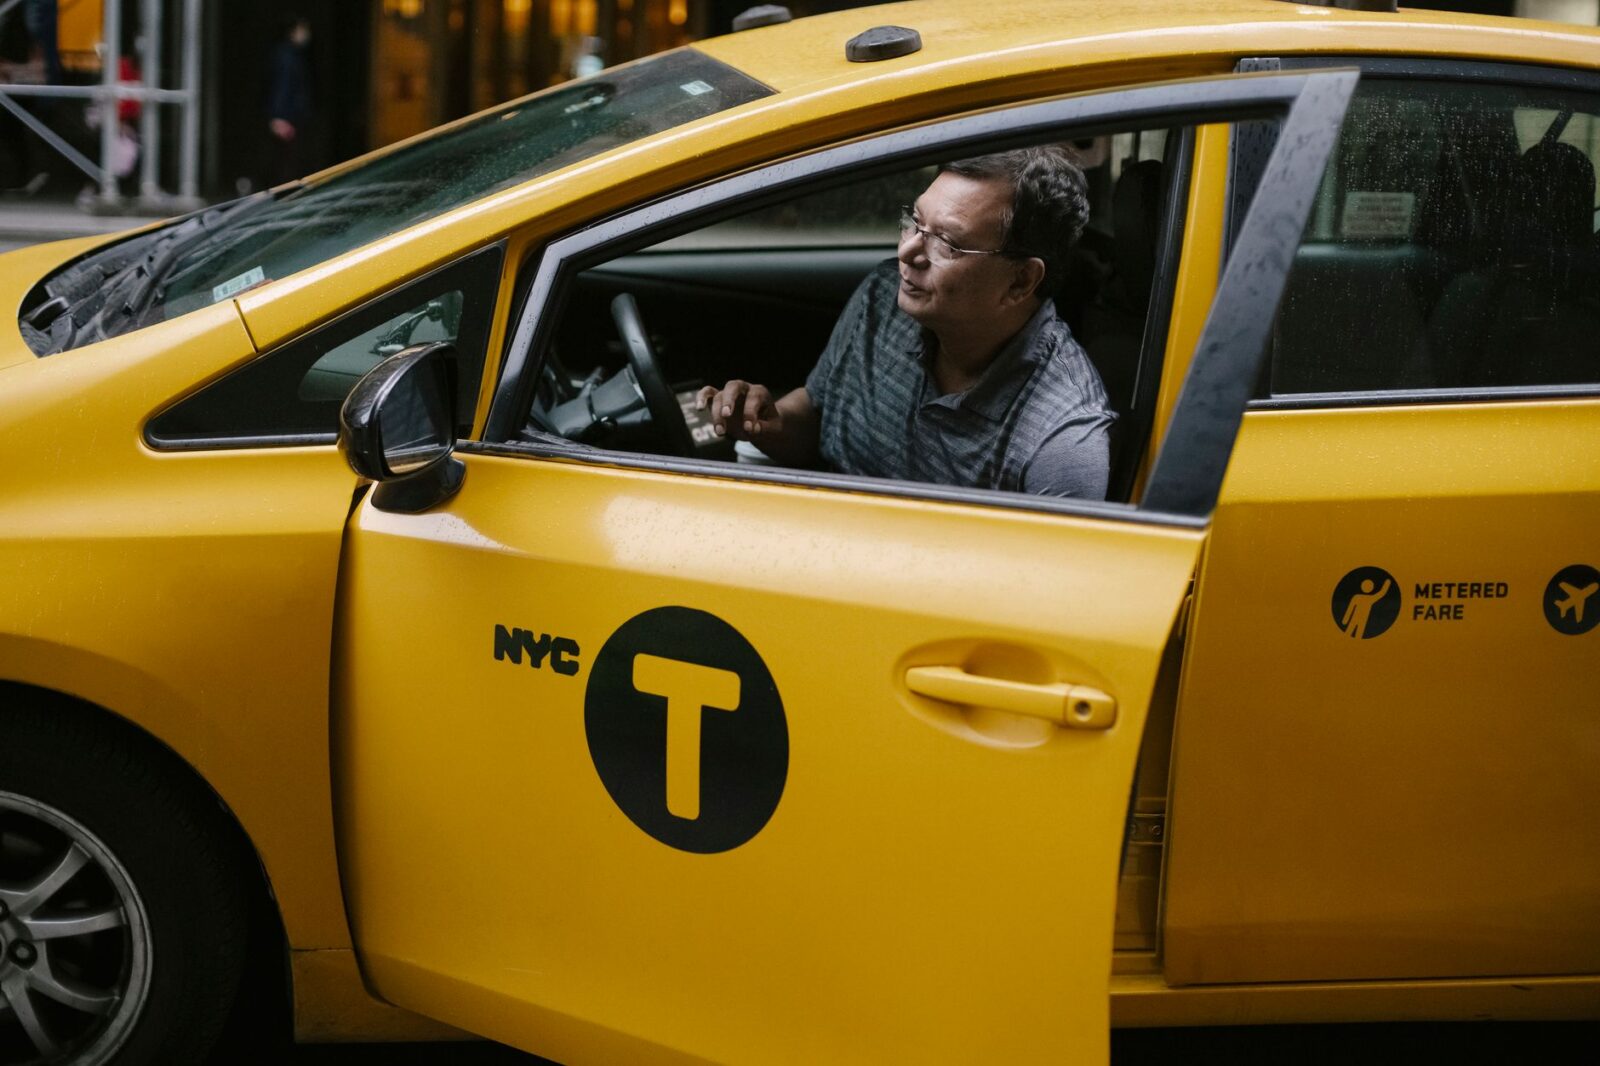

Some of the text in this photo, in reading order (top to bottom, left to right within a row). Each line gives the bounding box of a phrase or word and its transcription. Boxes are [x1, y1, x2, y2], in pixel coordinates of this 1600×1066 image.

[1414, 582, 1508, 599] METERED
[1412, 604, 1464, 620] FARE
[494, 624, 580, 677] NYC
[632, 653, 741, 821] T
